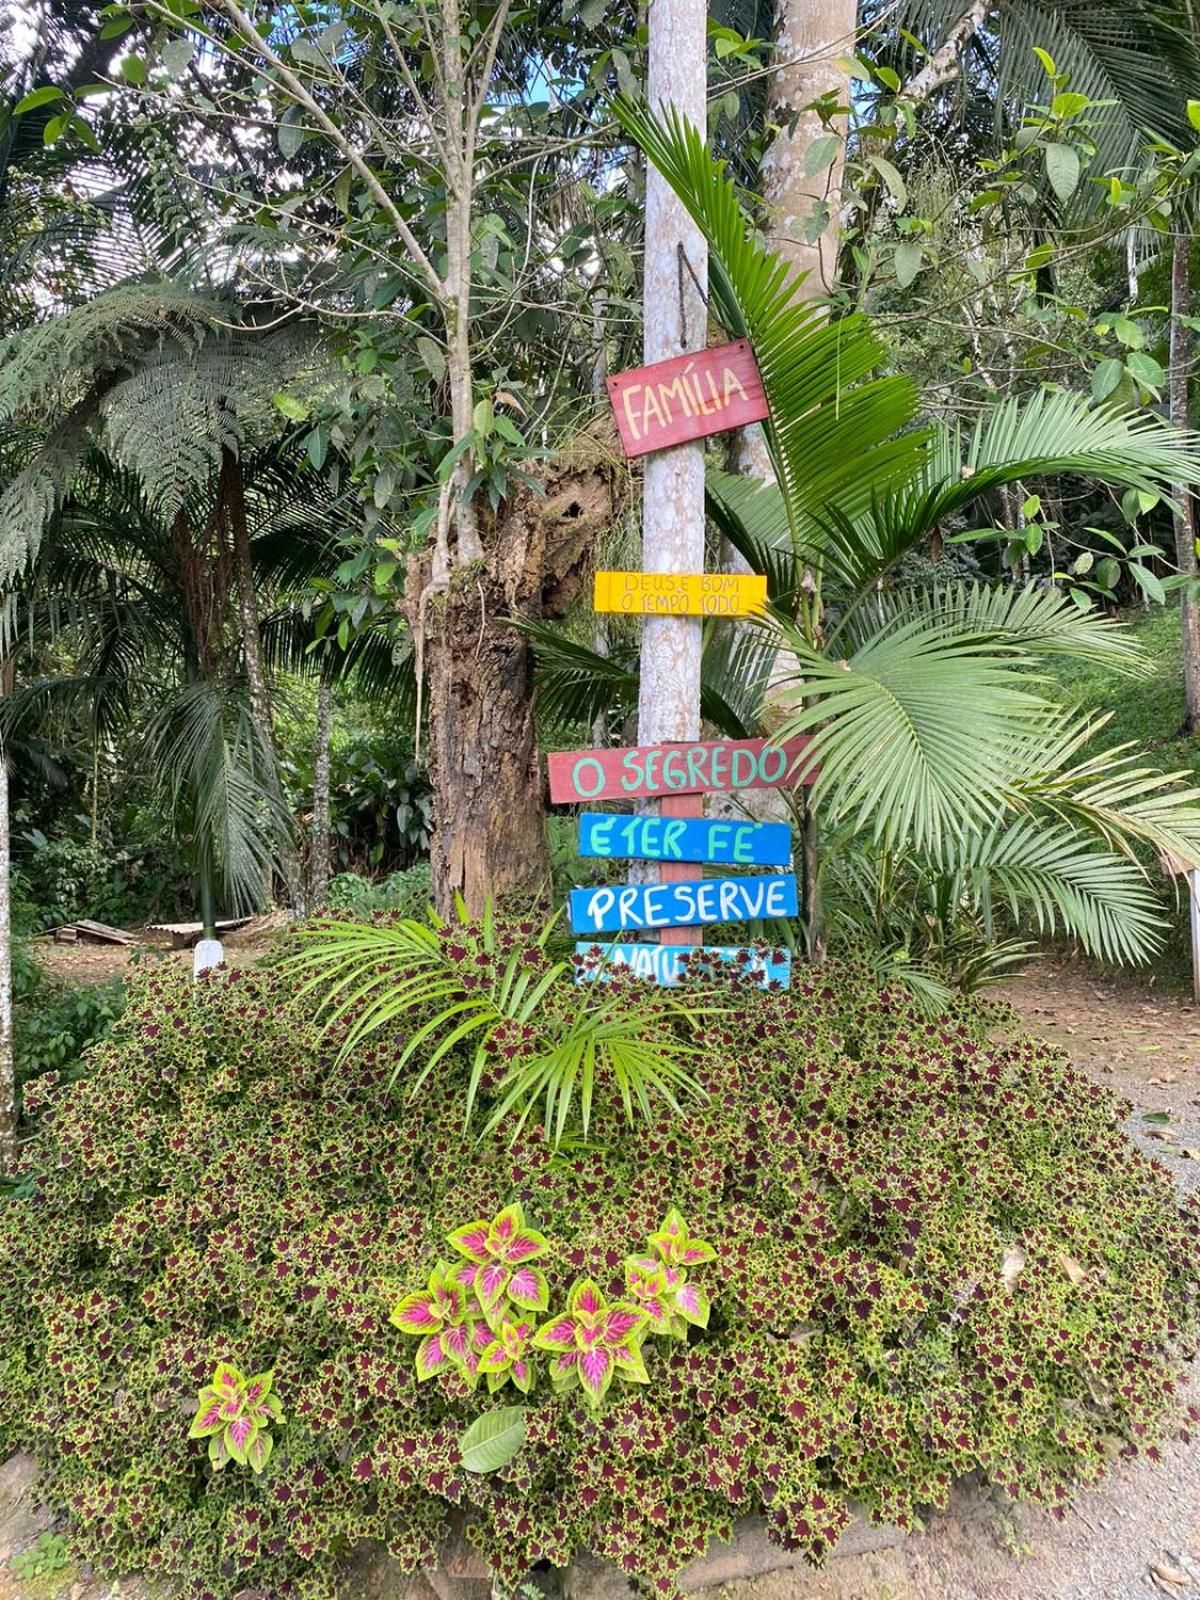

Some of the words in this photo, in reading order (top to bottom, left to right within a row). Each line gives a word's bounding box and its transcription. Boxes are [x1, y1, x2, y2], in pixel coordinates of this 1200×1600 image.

[622, 362, 749, 440] FAMÍLIA
[621, 593, 634, 610] O
[641, 593, 689, 613] TEMPO
[699, 593, 740, 614] TODO
[625, 574, 675, 592] DEUS
[701, 575, 739, 593] BOM
[573, 757, 606, 798] O
[621, 745, 787, 791] SEGREDO
[621, 817, 688, 859] TER
[707, 822, 764, 863] FÉ
[587, 881, 788, 929] PRESERVE
